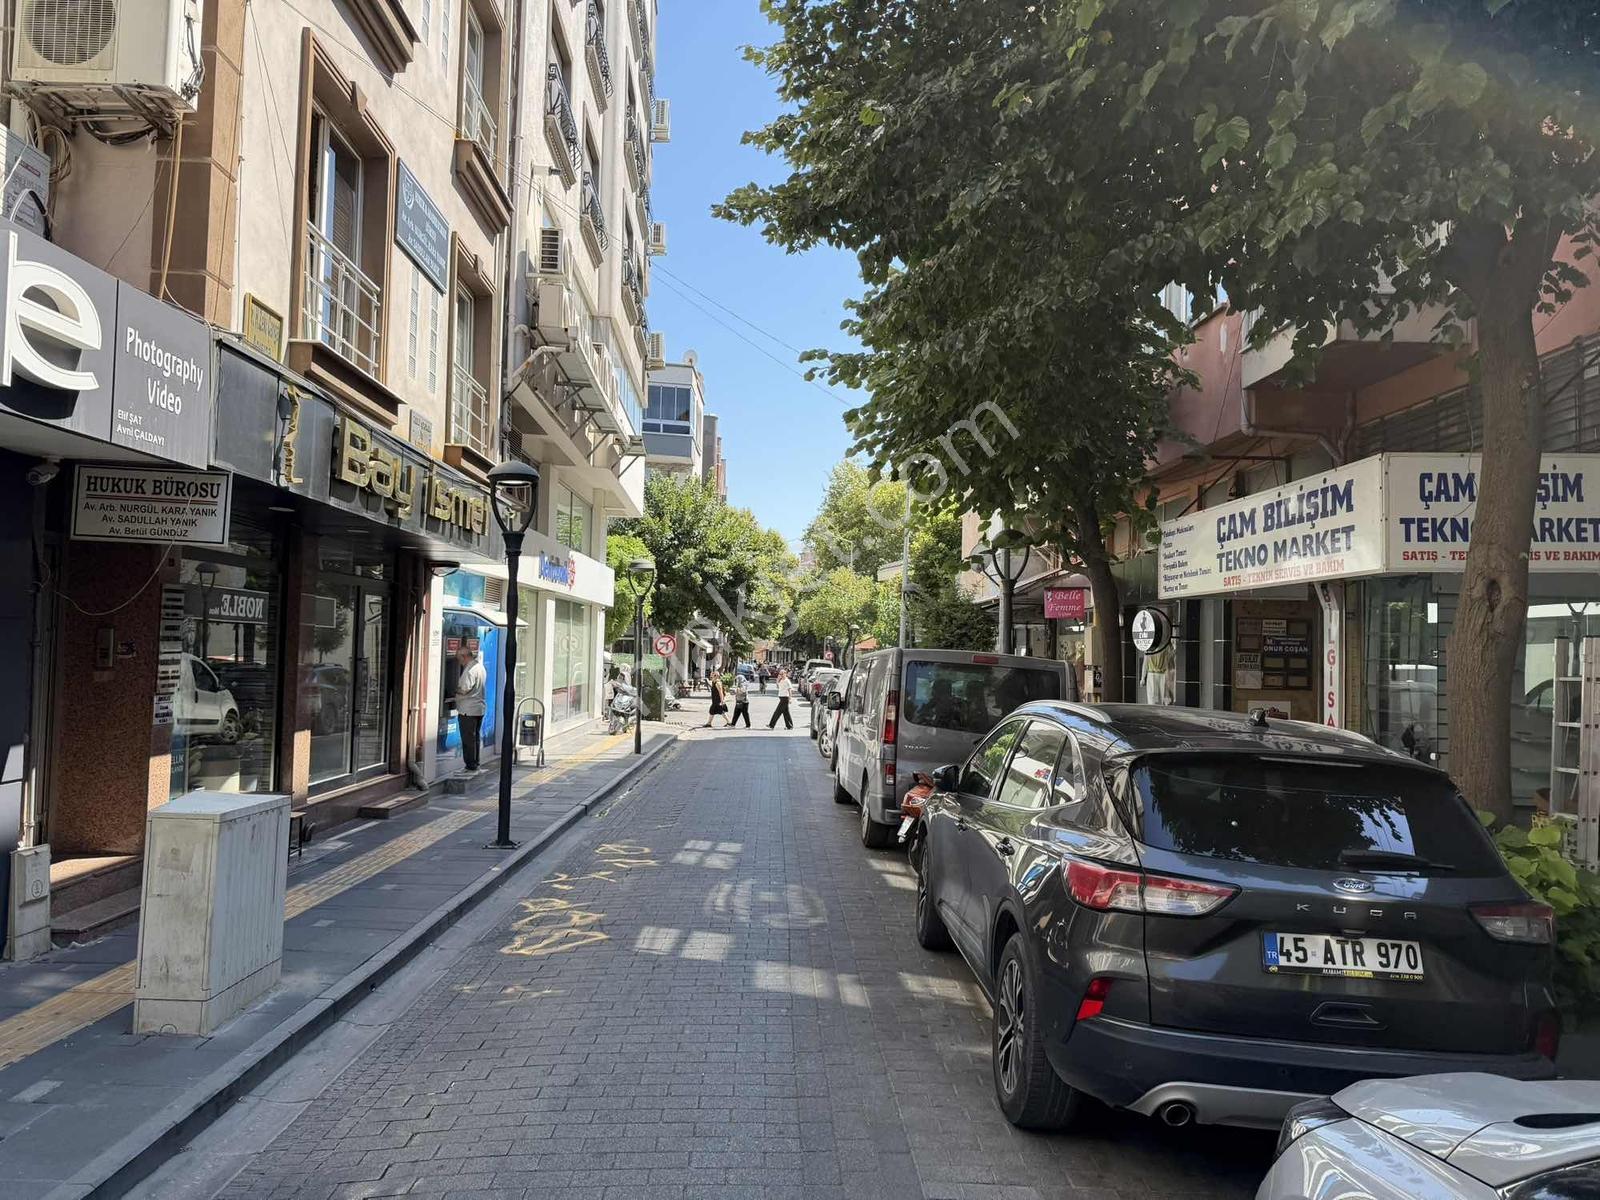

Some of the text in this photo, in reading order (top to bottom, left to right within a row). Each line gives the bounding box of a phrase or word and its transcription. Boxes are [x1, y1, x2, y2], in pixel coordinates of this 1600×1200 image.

[126, 326, 204, 392] Photography
[147, 377, 182, 415] Video
[340, 416, 416, 519] Bay
[86, 475, 222, 499] HUKUK BÜROSU
[1419, 463, 1584, 510] ÇAM ŞİM
[83, 502, 217, 517] Av. Arb. NURGÜL KARA YANIK
[1216, 477, 1355, 550] ÇAM BİLİŞİM
[102, 514, 198, 527] Av. SADULLAH YANIK
[1400, 516, 1600, 543] TEKN ARKET
[108, 527, 189, 537] Av. Betül GÜNDÜZ
[1216, 524, 1356, 573] TEKNO MARKET
[1402, 550, 1438, 563] SATIŞ
[1545, 550, 1560, 561] VE
[1304, 564, 1316, 575] VE
[1055, 590, 1081, 601] Belle
[1047, 603, 1081, 612] Femme
[1297, 903, 1417, 920] KUGA
[1267, 951, 1278, 960] TR
[1279, 936, 1419, 970] 45 ATR 970
